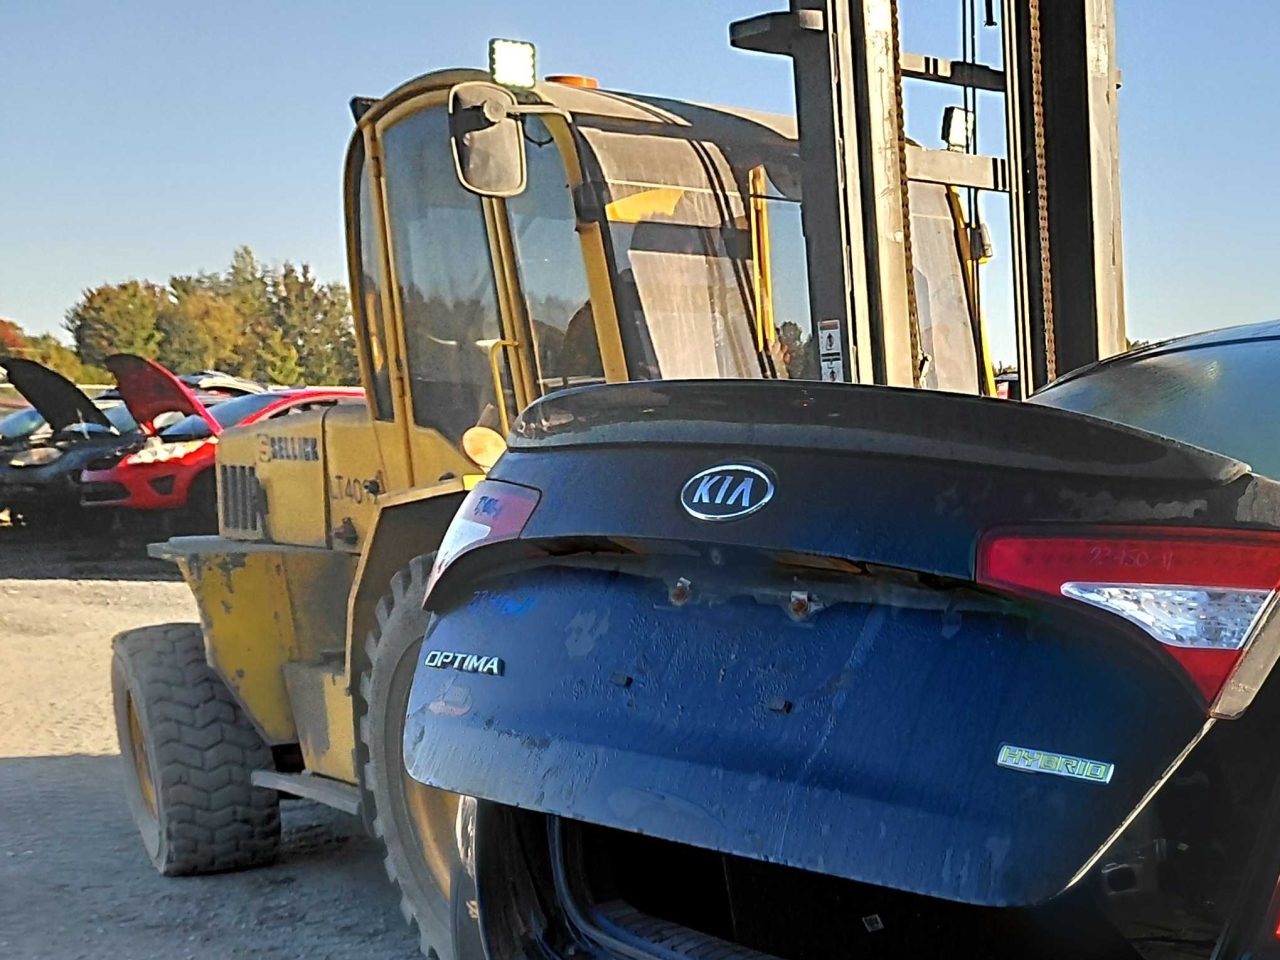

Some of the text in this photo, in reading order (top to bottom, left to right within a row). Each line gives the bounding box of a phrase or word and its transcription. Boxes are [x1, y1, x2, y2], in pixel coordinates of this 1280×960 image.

[692, 475, 754, 507] KIA
[424, 650, 500, 675] OPTIMA
[1000, 746, 1108, 780] HYBRID
